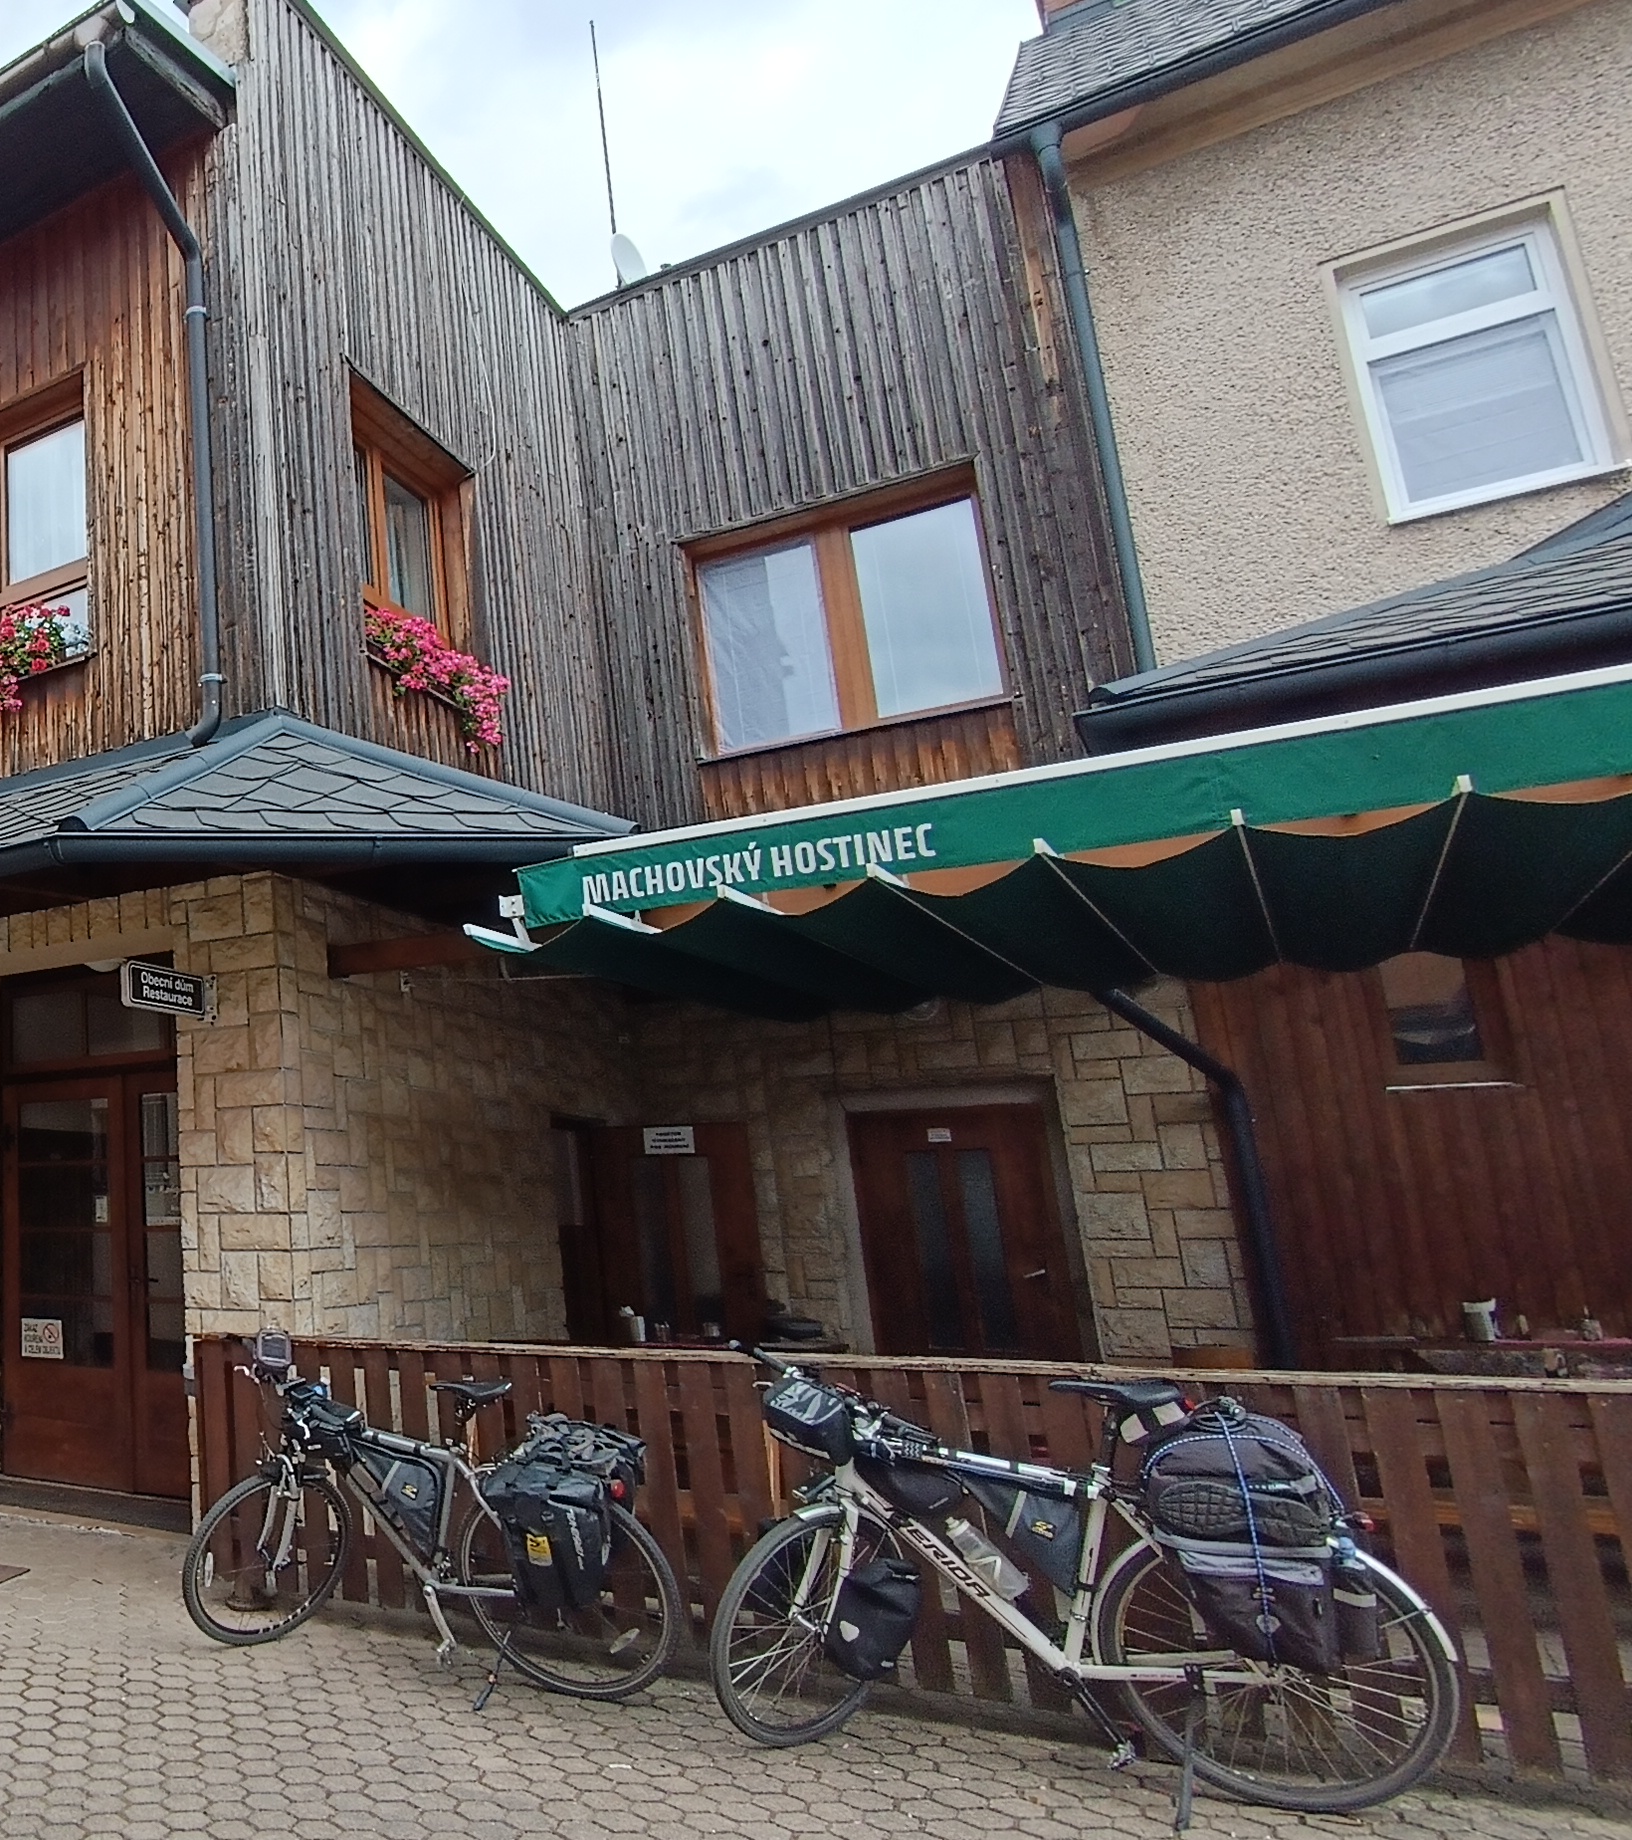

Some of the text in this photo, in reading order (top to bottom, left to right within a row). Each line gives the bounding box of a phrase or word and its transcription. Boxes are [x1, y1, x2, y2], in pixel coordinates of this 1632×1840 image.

[582, 823, 936, 904] MACHOVSKÝ HOSTINEC
[140, 971, 194, 993] Obecní dům
[142, 985, 193, 1006] Restaurace
[904, 1524, 990, 1598] ERIDA
